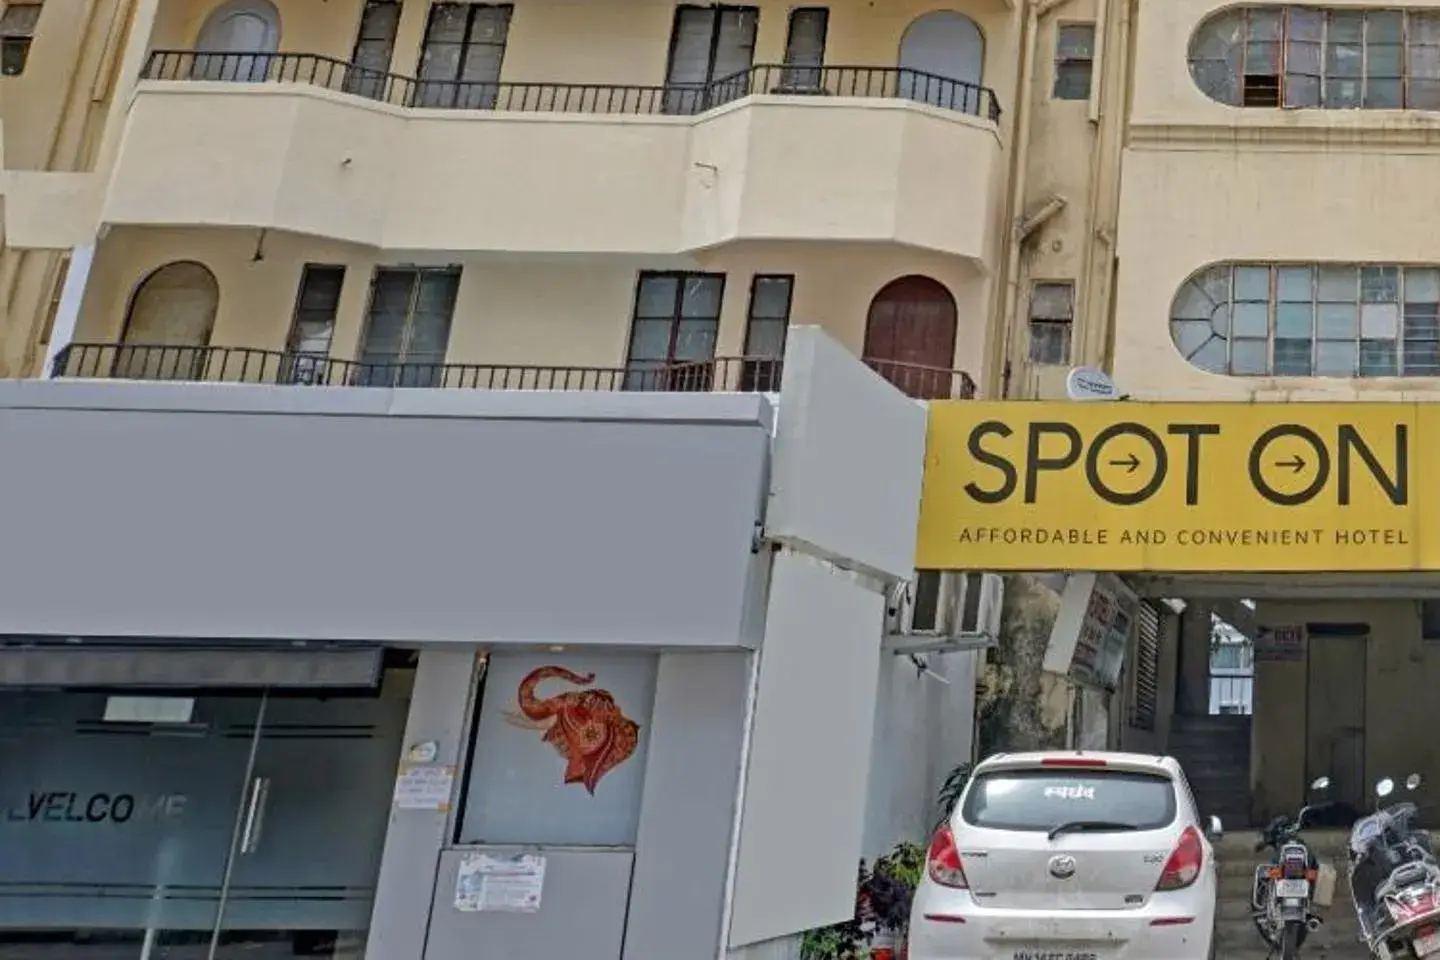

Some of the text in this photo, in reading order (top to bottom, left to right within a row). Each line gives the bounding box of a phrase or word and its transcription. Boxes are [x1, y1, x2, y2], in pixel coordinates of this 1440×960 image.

[963, 421, 1409, 507] SPOT ON
[959, 528, 1409, 546] AFFORDABLE AND CONVENIENT HOTEL
